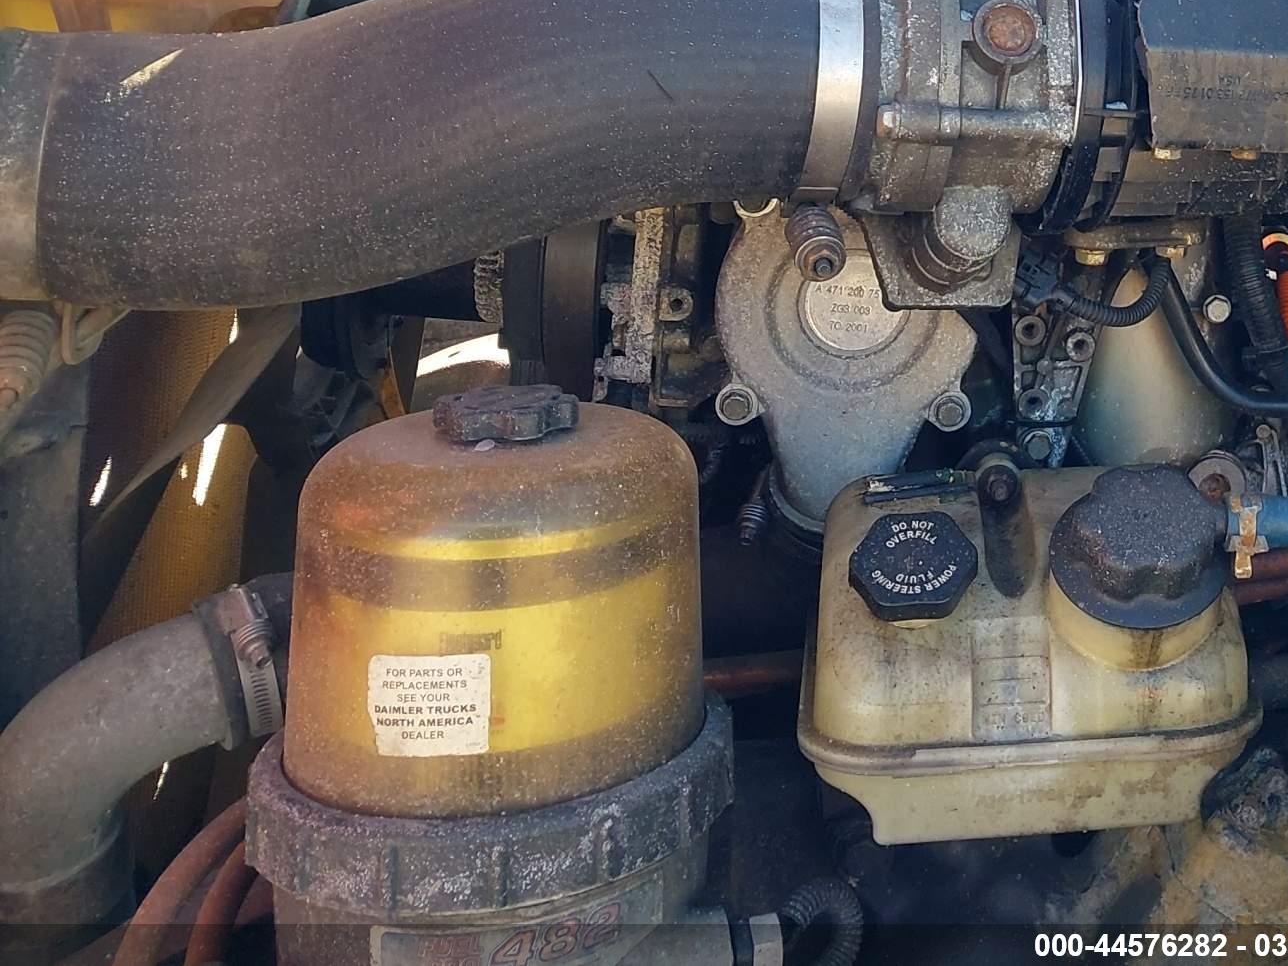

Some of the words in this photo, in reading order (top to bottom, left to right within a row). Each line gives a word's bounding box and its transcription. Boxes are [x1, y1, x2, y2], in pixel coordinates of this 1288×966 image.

[815, 284, 822, 294] A
[826, 285, 843, 296] 471
[891, 521, 907, 533] DO
[911, 520, 935, 531] NOT
[886, 530, 938, 548] OVERFILL
[871, 570, 922, 594] STEERING
[896, 571, 935, 584] FLUID
[924, 564, 957, 591] POWER
[386, 668, 407, 678] FOR
[409, 668, 444, 678] PARTS
[446, 667, 463, 677] OR
[382, 680, 468, 690] REPLACEMENTS
[397, 693, 417, 703] SEE
[420, 693, 451, 703] YOUR
[374, 704, 424, 715] DAIMLER
[427, 703, 477, 715] TRUCKS
[376, 717, 415, 728] NORTH
[401, 731, 445, 740] DEALER
[417, 935, 483, 957] FUEL
[489, 902, 622, 966] 482
